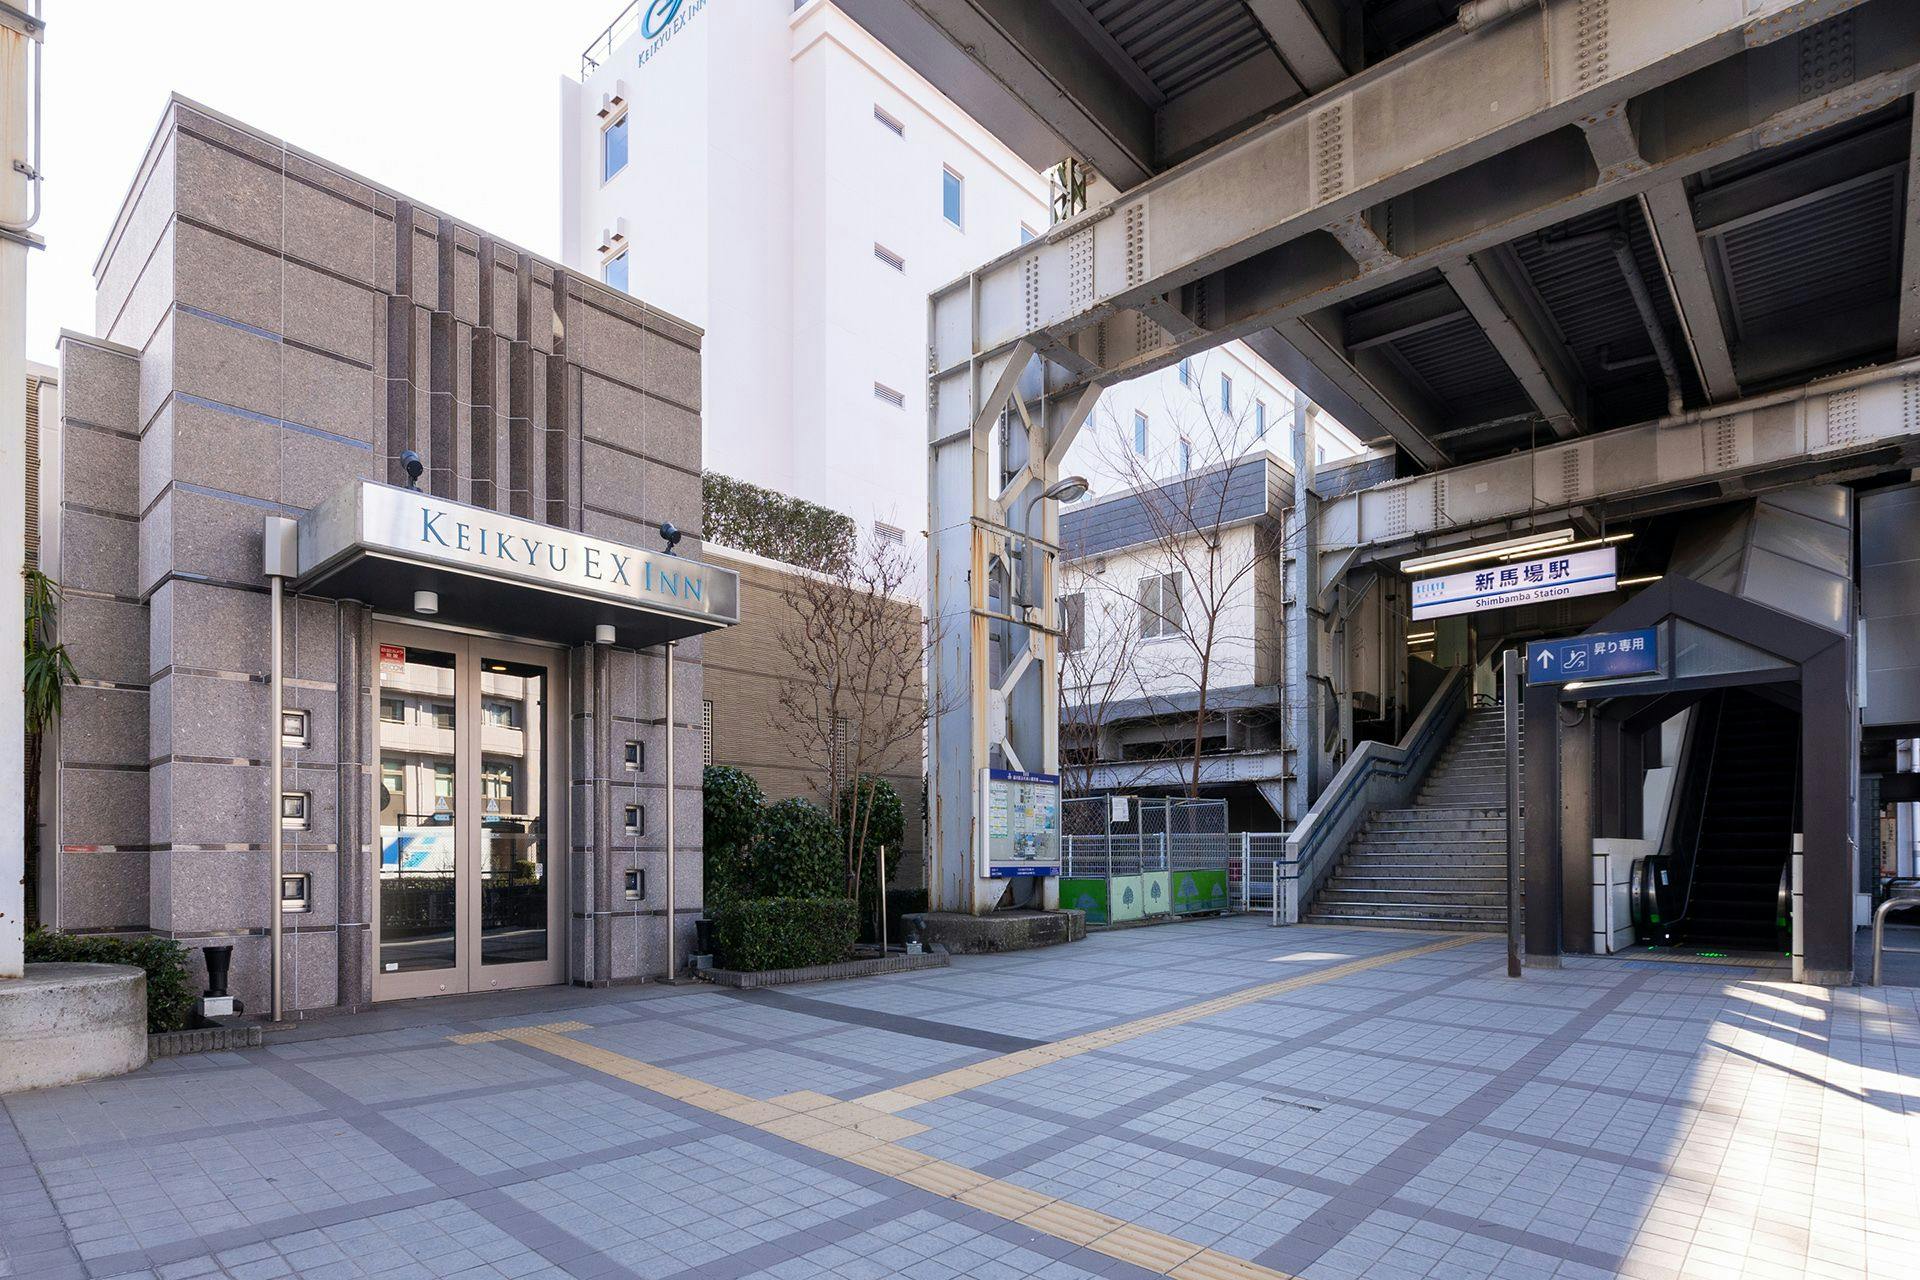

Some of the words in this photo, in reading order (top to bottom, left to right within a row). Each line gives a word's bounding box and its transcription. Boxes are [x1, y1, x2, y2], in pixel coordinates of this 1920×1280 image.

[638, 27, 671, 68] KEIKYU
[673, 11, 686, 35] EX
[421, 507, 568, 572] KEIKYU
[584, 546, 631, 587] EX
[644, 560, 703, 602] INN
[1475, 559, 1570, 592] 新馬場駅
[1475, 594, 1531, 608] Shimbamba
[1534, 586, 1570, 599] Station
[1594, 637, 1644, 656] 昇り専用
